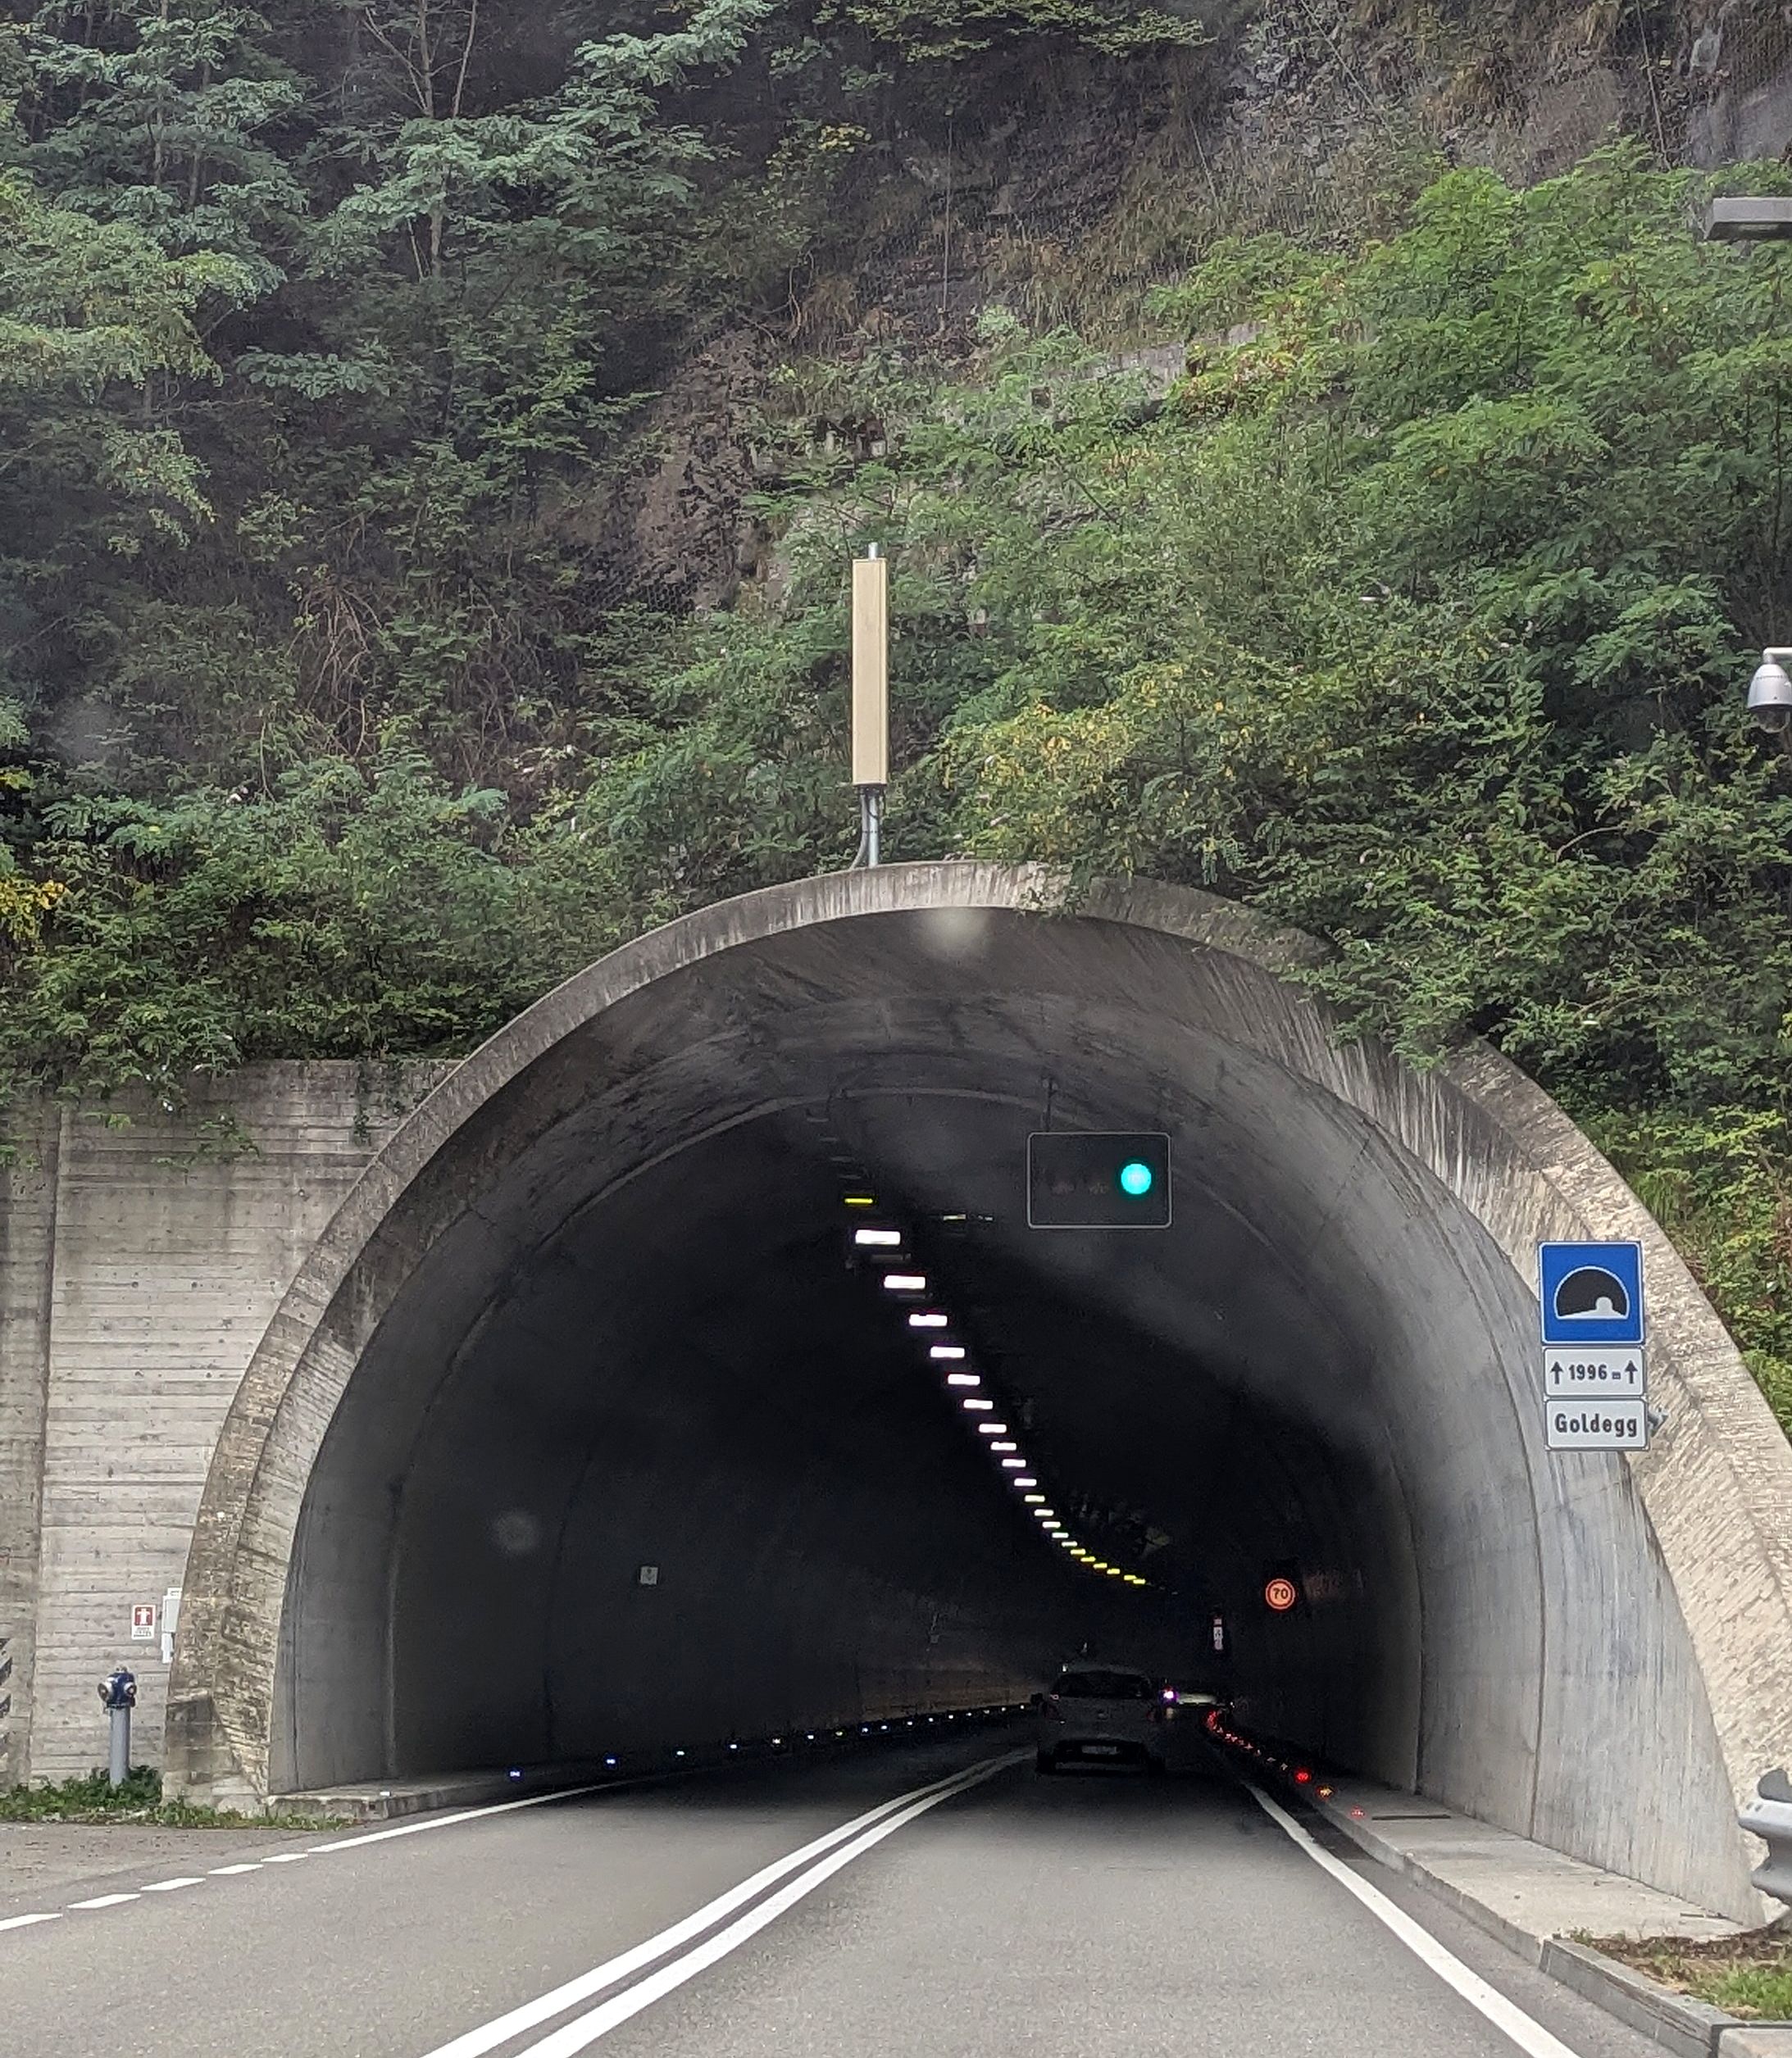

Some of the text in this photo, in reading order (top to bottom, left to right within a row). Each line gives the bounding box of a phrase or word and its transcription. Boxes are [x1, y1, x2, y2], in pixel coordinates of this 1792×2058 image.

[1569, 1365, 1607, 1380] 1996
[1555, 1413, 1638, 1438] Goldegg
[1272, 1588, 1289, 1599] 70
